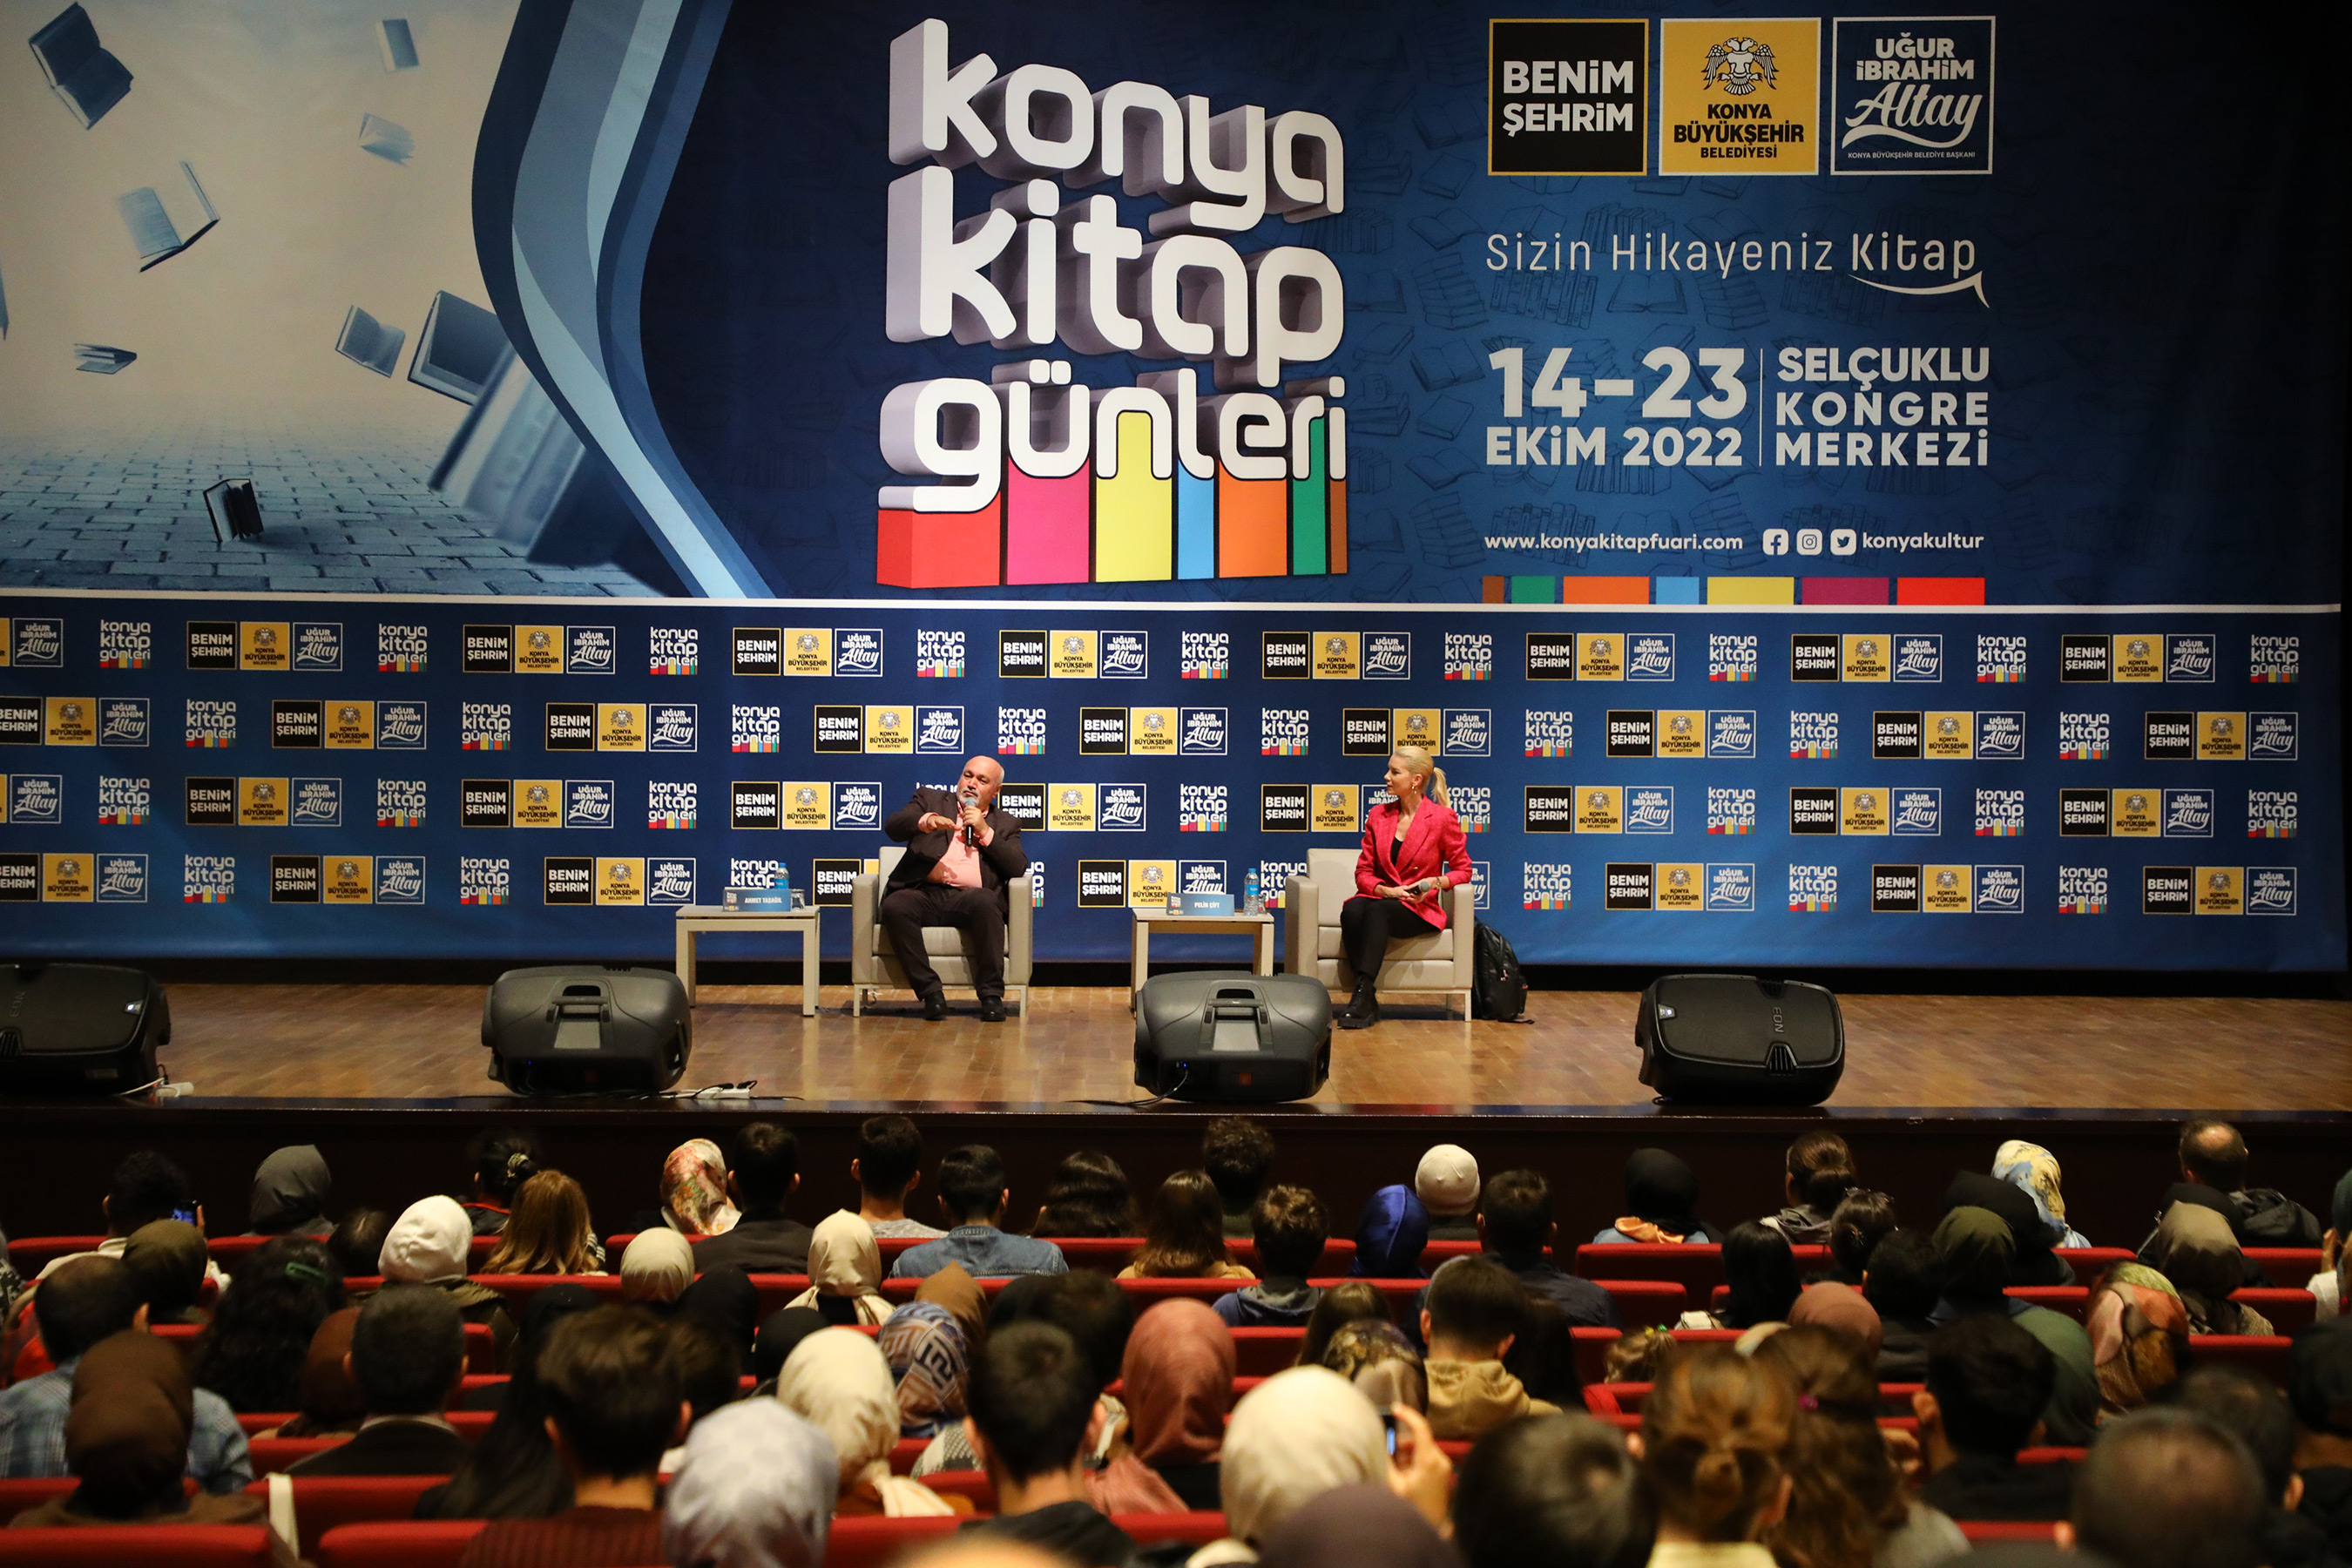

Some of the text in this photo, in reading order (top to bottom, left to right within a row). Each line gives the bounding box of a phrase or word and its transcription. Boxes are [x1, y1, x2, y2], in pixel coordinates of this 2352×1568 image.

[1876, 32, 1955, 58] UĞUR
[1707, 104, 1772, 119] KONYA
[1842, 82, 1984, 149] Altay
[889, 17, 1344, 235] konya
[1673, 121, 1804, 145] BÜYÜKŞEHİR
[1700, 144, 1777, 159] BELEDİYESİ
[1873, 151, 1913, 159] BÜYÜKŞEHİR
[1485, 232, 1976, 280] Sizin Hikayeniz Kitap
[886, 166, 1344, 387] kitap
[1777, 348, 1990, 390] SELÇUKLU
[1776, 392, 1989, 426] KONGRE
[878, 360, 1346, 513] günleri
[1622, 427, 1742, 466] 2022
[1776, 429, 1989, 465] MERKEZİ
[1484, 532, 1743, 554] www.konyakitapfuari.com
[1862, 531, 1984, 552] konyakultur
[100, 619, 151, 635] konya
[100, 632, 151, 651] kitap
[917, 629, 964, 645] konya
[1181, 631, 1228, 646] konya
[1709, 634, 1757, 649] konya
[2250, 634, 2299, 650] konya
[100, 649, 151, 662] günleri
[838, 649, 879, 668] Altay
[917, 642, 964, 659] kitap
[1181, 644, 1228, 661] kitap
[1709, 646, 1757, 664] kitap
[2250, 647, 2299, 665] kitap
[917, 658, 964, 671] günleri
[1181, 659, 1228, 672] günleri
[1366, 652, 1407, 672] Altay
[1709, 662, 1757, 675] günleri
[2170, 654, 2212, 674] Altay
[2250, 664, 2299, 676] günleri
[732, 704, 780, 720] konya
[1261, 708, 1308, 724] konya
[2060, 712, 2110, 727] konya
[732, 717, 780, 734] kitap
[1261, 721, 1308, 738] kitap
[2060, 725, 2110, 742] kitap
[732, 733, 780, 746] günleri
[1184, 727, 1224, 747] Altay
[1261, 736, 1308, 749] günleri
[2060, 740, 2110, 753] günleri
[377, 779, 426, 794] konya
[1976, 787, 2024, 803] konya
[377, 792, 426, 809] kitap
[377, 808, 426, 821] günleri
[569, 801, 610, 820] Altay
[1896, 808, 1937, 828] Altay
[1976, 801, 2024, 818] kitap
[1976, 817, 2024, 829] günleri
[184, 855, 235, 870] konya
[1524, 862, 1571, 877] konya
[184, 868, 235, 885] kitap
[1524, 875, 1571, 892] kitap
[184, 883, 235, 896] günleri
[1524, 890, 1571, 903] günleri
[1710, 883, 1751, 902] Altay
[1772, 1007, 1784, 1033] EON
